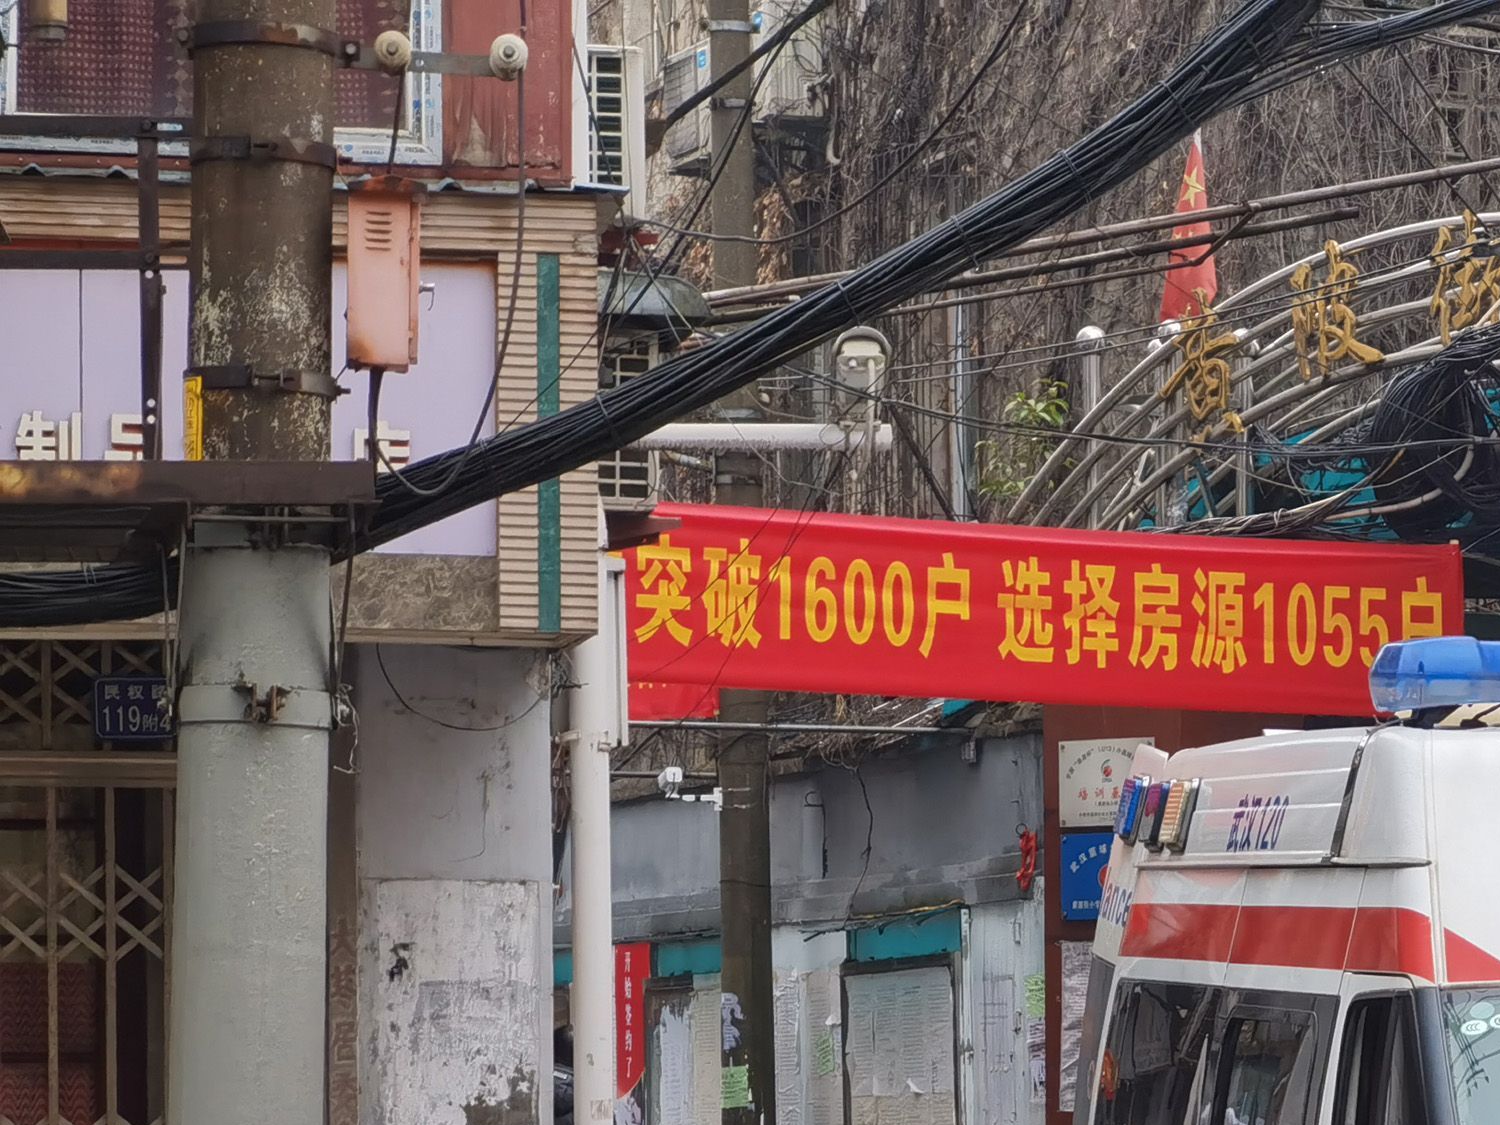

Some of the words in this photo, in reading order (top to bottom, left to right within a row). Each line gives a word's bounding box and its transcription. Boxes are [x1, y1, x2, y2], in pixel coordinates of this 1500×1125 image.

[634, 533, 971, 660] 突破1600户
[1226, 793, 1290, 853] 武汉120
